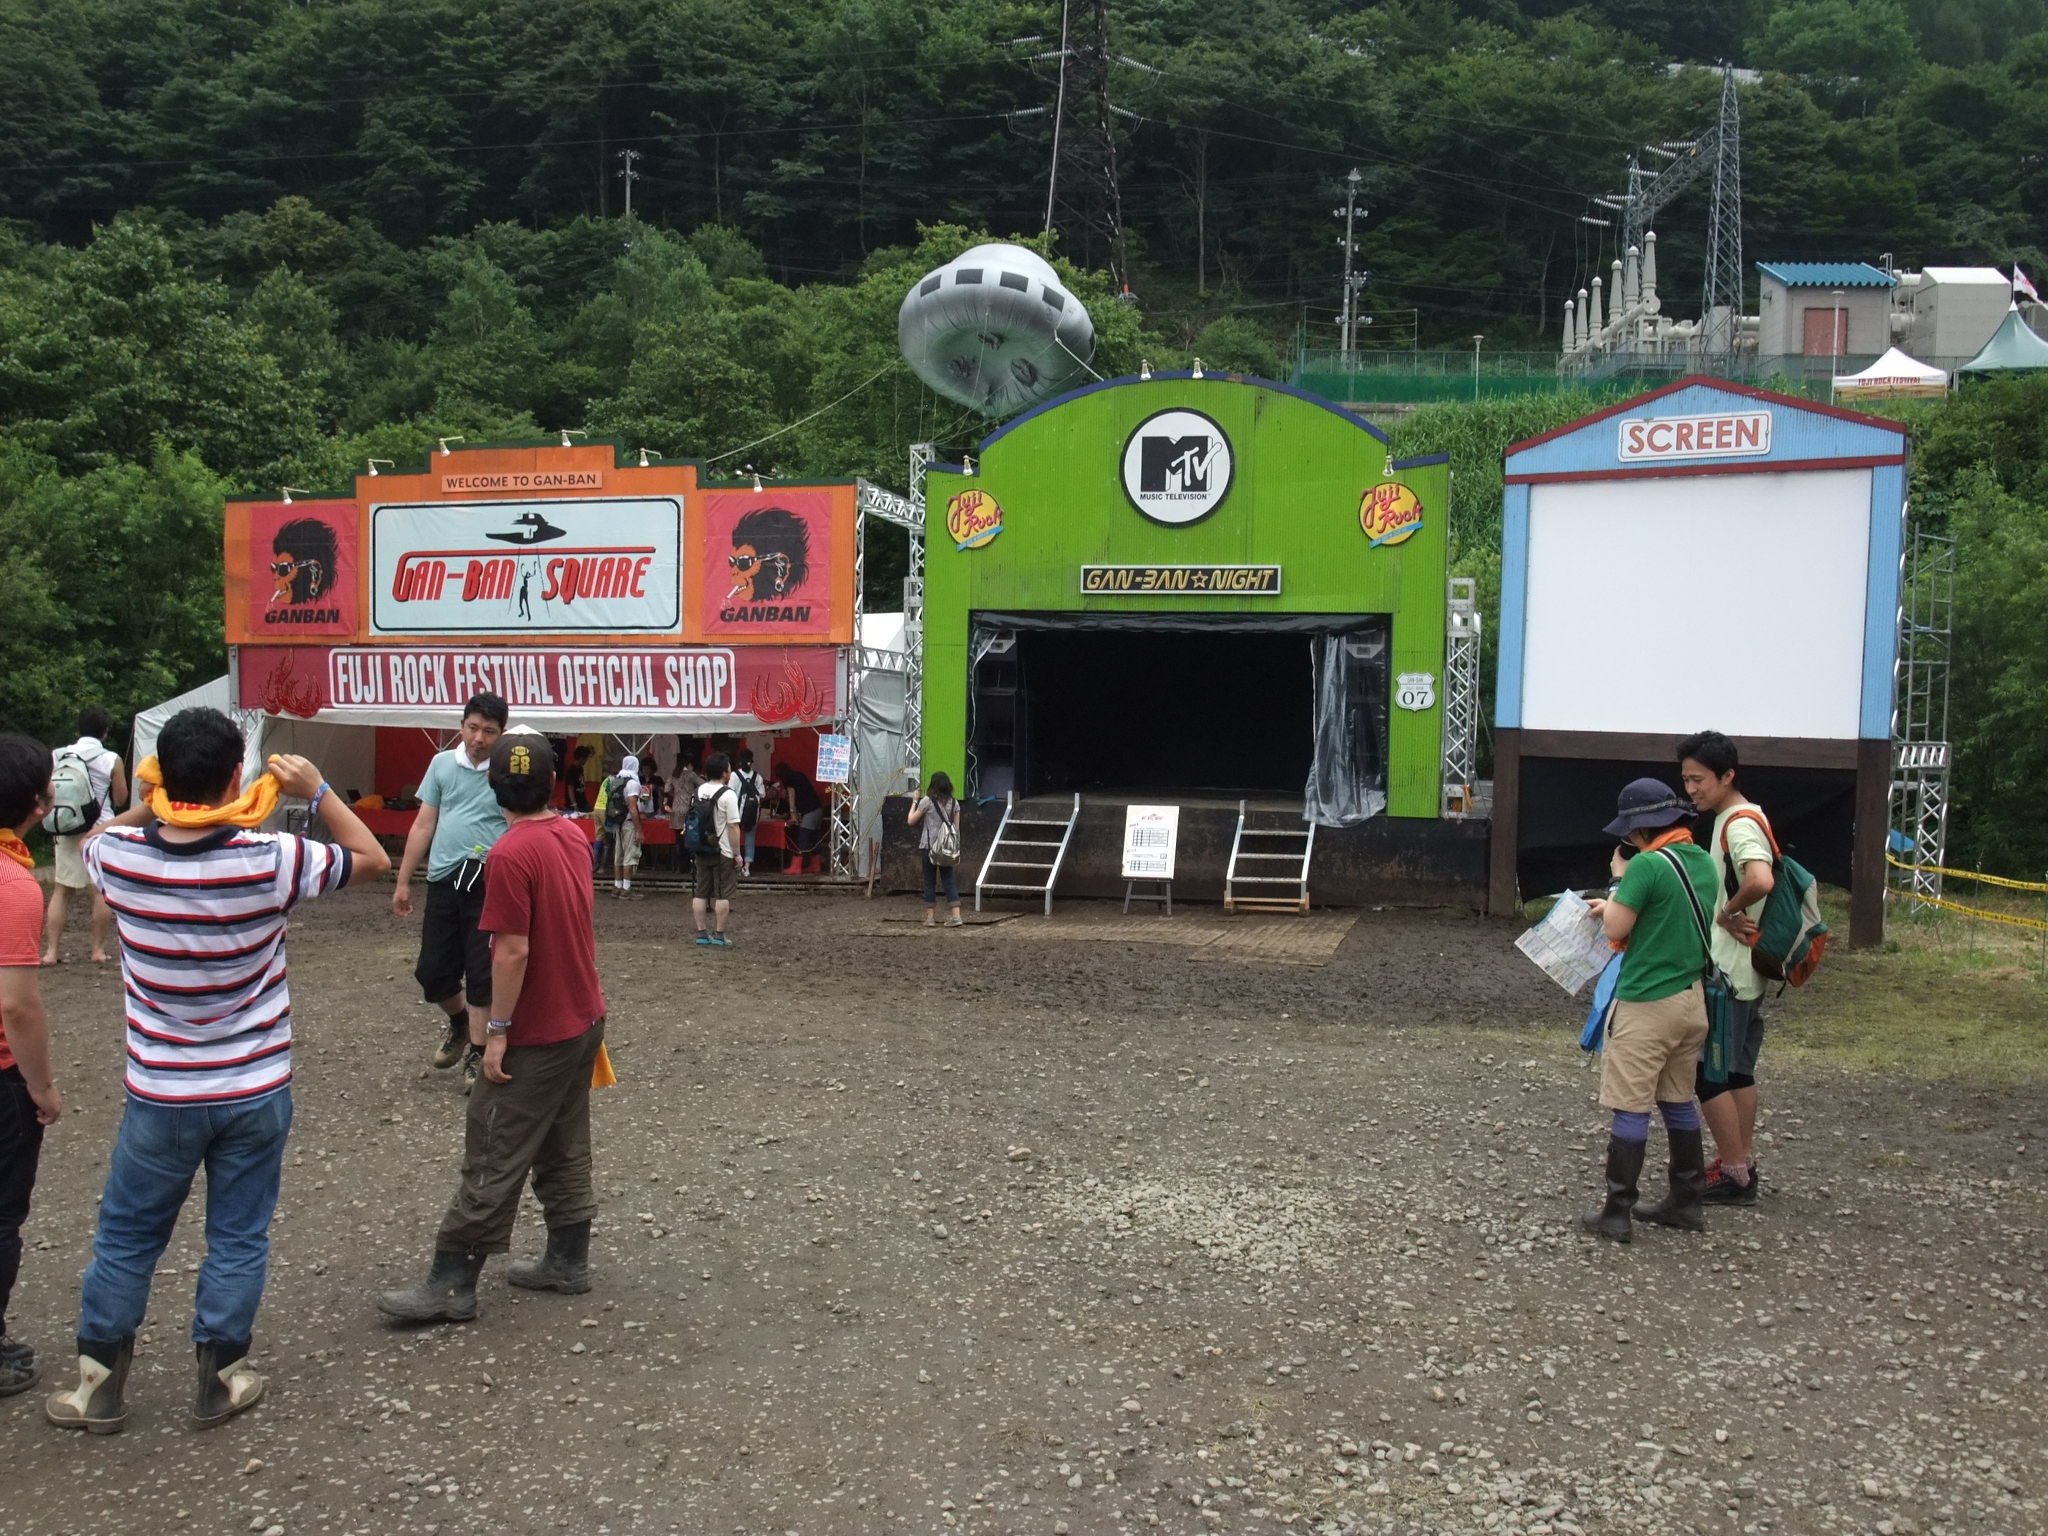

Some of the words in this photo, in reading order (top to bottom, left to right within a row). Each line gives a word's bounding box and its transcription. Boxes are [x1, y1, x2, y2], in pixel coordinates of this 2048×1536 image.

[1627, 418, 1760, 454] SCREEN
[1140, 435, 1222, 492] MTV
[446, 476, 508, 488] WELCOME
[513, 475, 529, 486] TO
[533, 474, 596, 486] GAN-BAN
[391, 547, 518, 602] GAN-BAN
[540, 557, 652, 605] SQUARE
[1208, 570, 1274, 590] NIGHT
[264, 608, 340, 624] GANBAN
[720, 605, 811, 622] GANBAN
[337, 654, 385, 704] FUJI
[390, 654, 450, 704] ROCK
[453, 655, 554, 705] FESTIVAL
[557, 654, 660, 706] OFFICIAL
[664, 655, 728, 707] SHOP
[1402, 690, 1429, 706] 07
